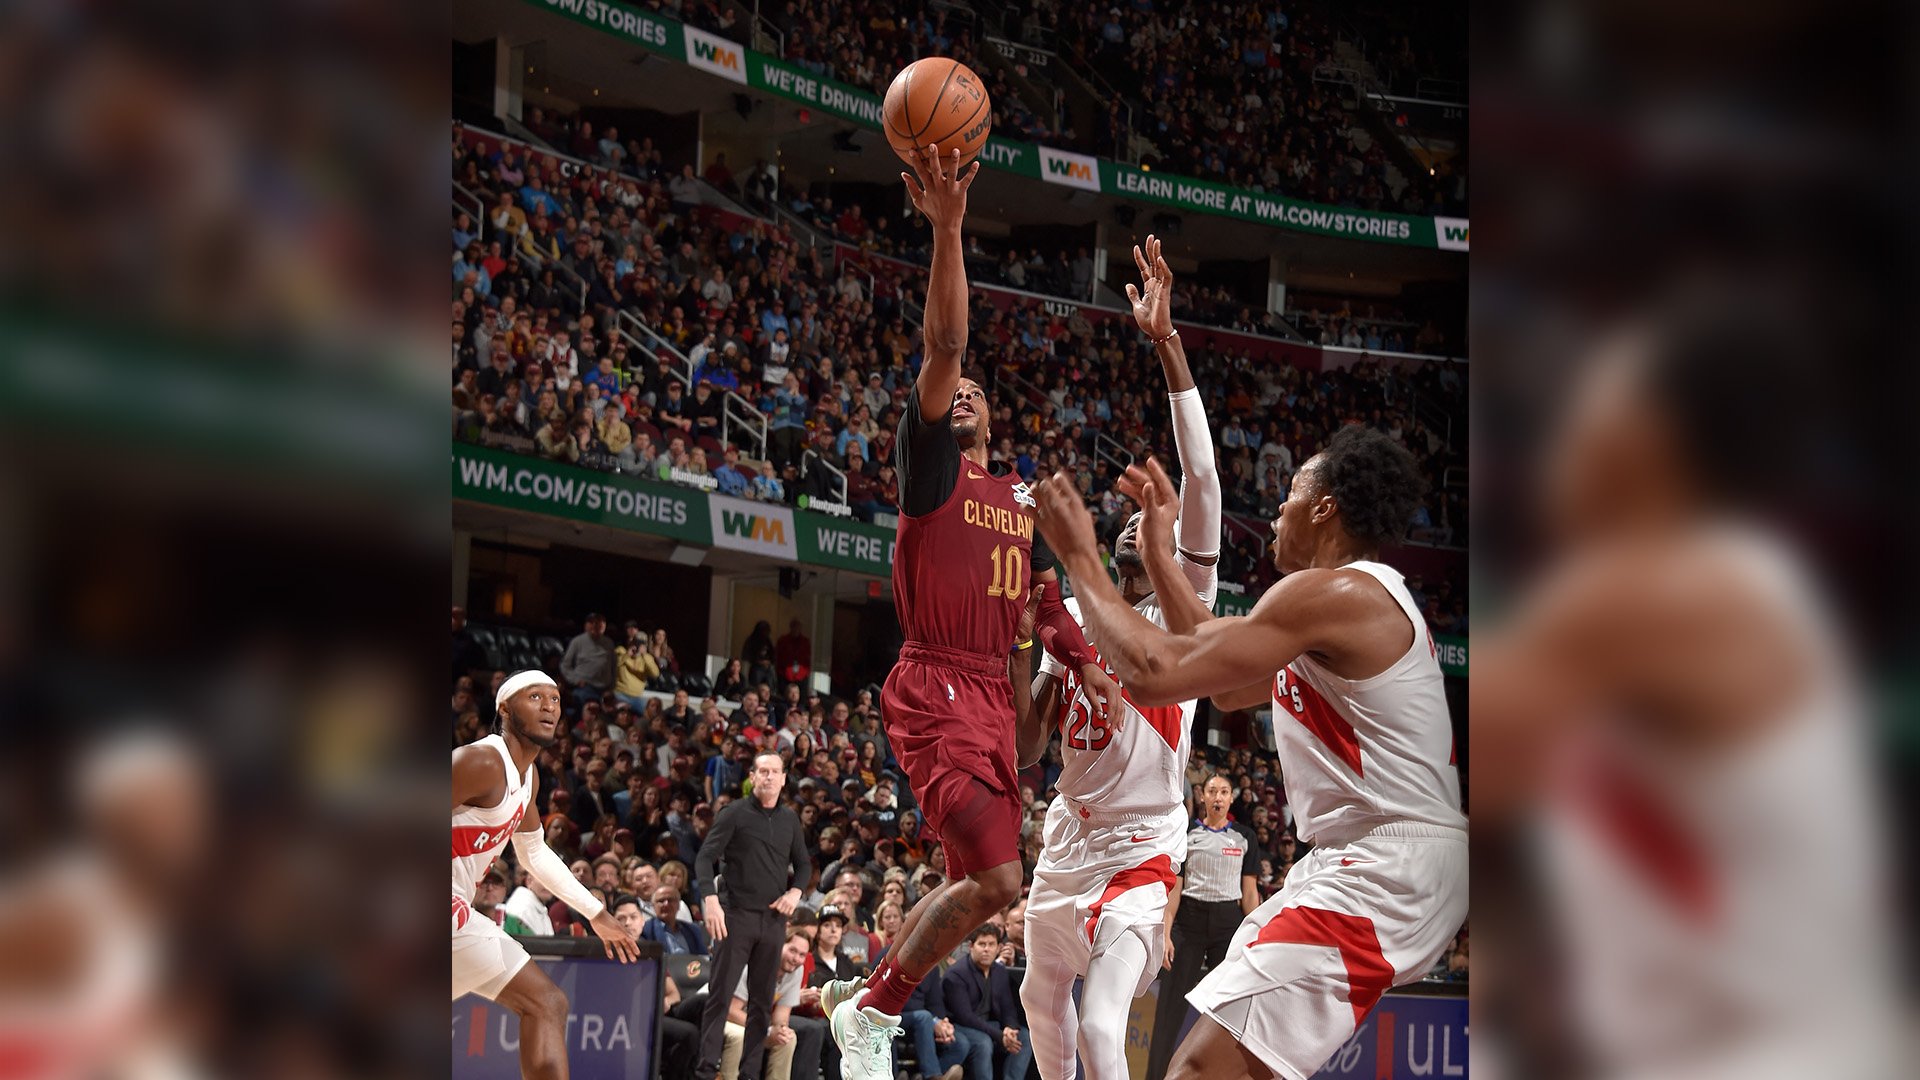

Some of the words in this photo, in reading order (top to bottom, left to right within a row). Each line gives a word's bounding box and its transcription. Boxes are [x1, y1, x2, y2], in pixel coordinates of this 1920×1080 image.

[694, 39, 739, 71] WM
[763, 63, 818, 101] WE'RE
[1048, 157, 1092, 182] WM
[1117, 171, 1173, 199] LEARN
[1177, 184, 1226, 210] MORE
[1230, 195, 1251, 214] AT
[1255, 199, 1410, 239] WM.COM/STORIES
[1445, 225, 1469, 241] W
[460, 457, 687, 525] WM.COM/STORIES
[671, 466, 718, 490] Huntington
[809, 495, 851, 518] Huntington
[964, 499, 1034, 542] CLEVELAN
[722, 509, 786, 545] WM
[817, 527, 882, 562] WE'RE
[987, 544, 1022, 600] 10
[1408, 1023, 1469, 1075] UL
